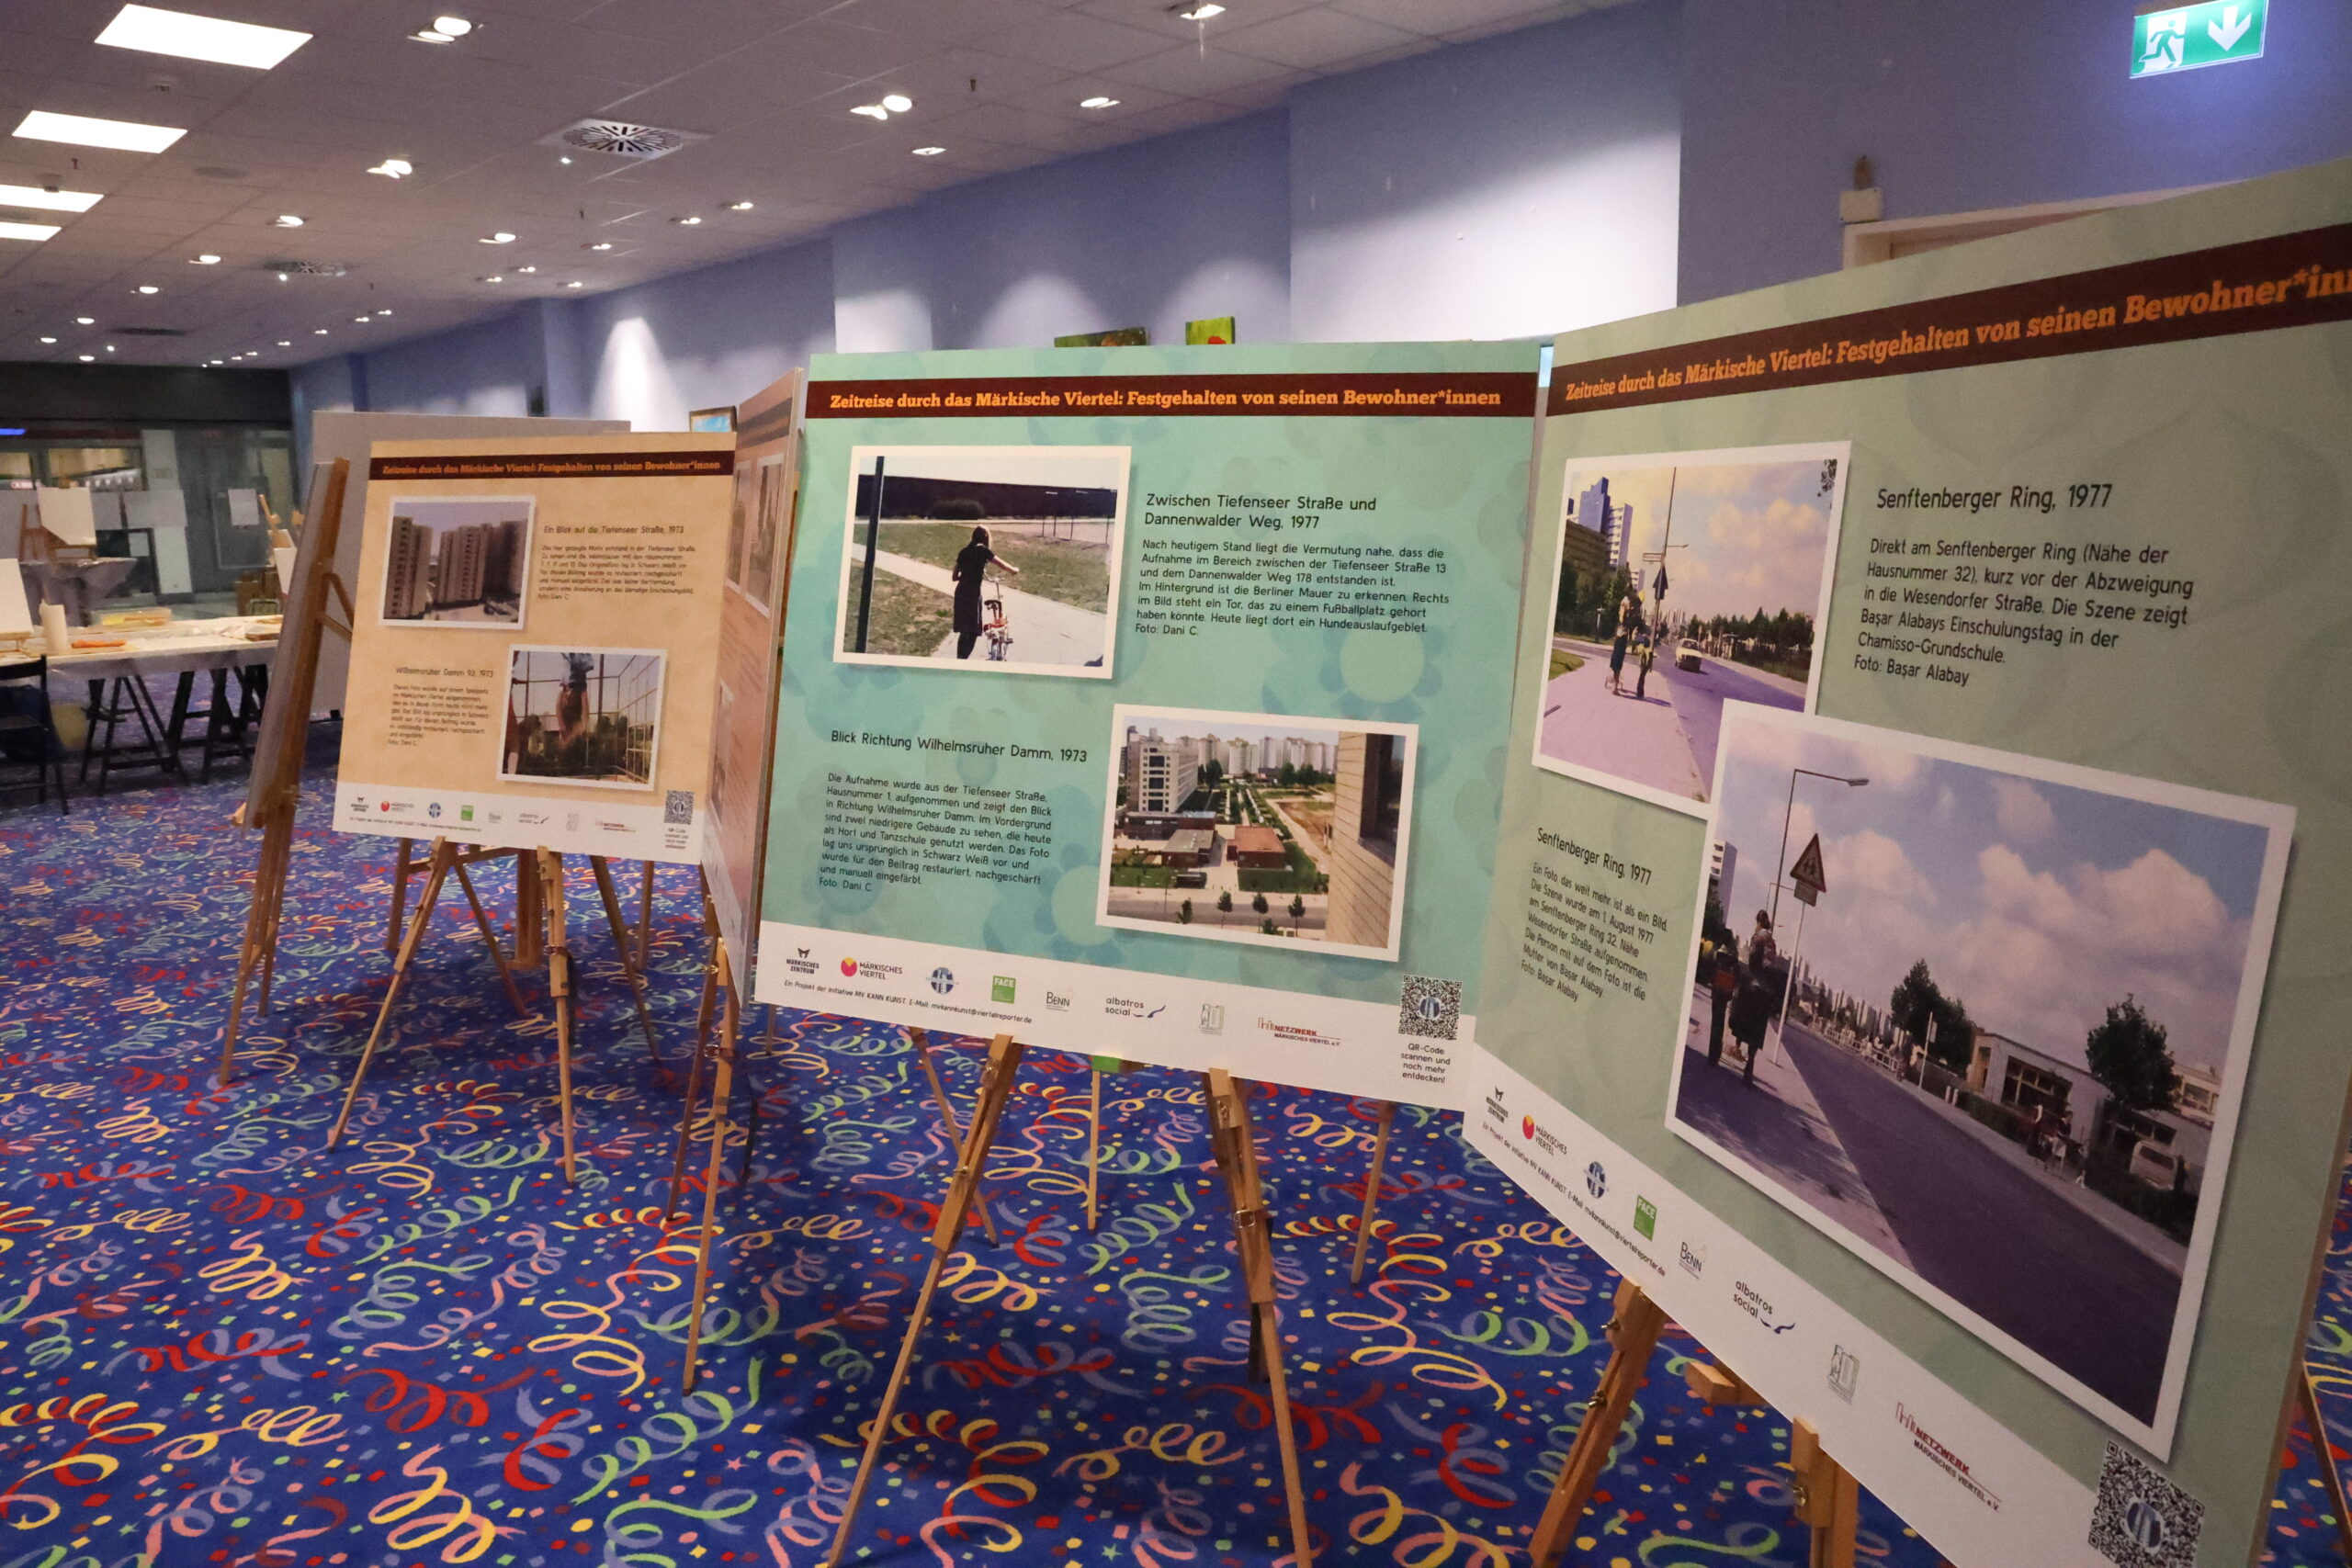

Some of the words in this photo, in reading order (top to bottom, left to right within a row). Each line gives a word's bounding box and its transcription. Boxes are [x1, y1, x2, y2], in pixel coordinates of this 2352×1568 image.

[1565, 378, 1616, 400] Zeitreise
[1617, 369, 1655, 393] durch
[1657, 367, 1682, 388] das
[1684, 355, 1766, 384] Märkische
[1770, 344, 1832, 372] Viertel:
[1835, 328, 1969, 364] Festgehalten
[1975, 321, 2020, 344] von
[2026, 309, 2116, 337] seinen
[830, 393, 894, 408] Zeitreise
[897, 392, 941, 407] durch
[944, 392, 972, 407] das
[975, 390, 1060, 406] Märkische
[1063, 390, 1124, 405] Viertel:
[1126, 389, 1237, 409] Festgehalten
[1241, 393, 1274, 404] von
[1278, 389, 1339, 404] seinen
[1146, 492, 1210, 507] Zwischen
[1216, 494, 1291, 508] Tiefenseer
[1350, 497, 1376, 510] und
[1876, 487, 2002, 513] Senftenberger
[2009, 485, 2055, 513] Ring,
[2068, 483, 2112, 507] 1977
[1144, 512, 1242, 526] Dannenwalder
[1249, 514, 1283, 531] Weg,
[1291, 515, 1319, 528] 1977
[1142, 538, 1167, 548] Nach
[1170, 539, 1218, 552] heutigem
[1223, 541, 1251, 552] Stand
[1255, 542, 1277, 555] liegt
[1282, 543, 1298, 553] die
[1303, 544, 1361, 558] Vermutung
[1398, 547, 1422, 558] dass
[1427, 547, 1444, 558] die
[1870, 537, 1906, 554] Direkt
[1910, 543, 1930, 555] am
[1936, 539, 2036, 563] Senftenberger
[2042, 542, 2076, 565] Ring
[2138, 545, 2169, 564] der
[1141, 553, 1193, 564] Aufnahme
[1196, 555, 1209, 564] im
[1213, 555, 1251, 566] Bereich
[1255, 558, 1305, 568] zwischen
[1308, 558, 1327, 569] der
[1331, 558, 1389, 570] Tiefenseer
[1435, 562, 1446, 573] 13
[1139, 568, 1159, 577] und
[1162, 568, 1184, 578] dem
[1188, 569, 1262, 581] Dannenwalder
[1266, 571, 1292, 584] Weg
[1296, 572, 1312, 582] 178
[1316, 574, 1376, 585] entstanden
[1867, 561, 1948, 581] Hausnummer
[1984, 566, 2014, 585] kurz
[2020, 572, 2045, 586] vor
[2051, 570, 2078, 588] der
[2085, 571, 2194, 598] Abzweigung
[1138, 581, 1151, 591] Im
[1155, 581, 1214, 594] Hintergrund
[1217, 584, 1229, 594] ist
[1233, 584, 1250, 595] die
[1253, 585, 1294, 597] Berliner
[1298, 587, 1333, 598] Mauer
[1337, 591, 1350, 599] zu
[1412, 592, 1449, 604] Rechts
[1137, 595, 1150, 604] im
[1154, 595, 1171, 605] Bild
[1175, 597, 1201, 607] steht
[1205, 598, 1221, 608] ein
[1247, 600, 1265, 610] das
[1269, 603, 1282, 611] zu
[1285, 602, 1318, 612] einem
[1323, 603, 1385, 616] Fußballplatz
[1863, 584, 1874, 600] in
[1879, 586, 1896, 602] die
[1903, 587, 1988, 609] Wesendorfer
[2052, 596, 2077, 616] Die
[2085, 599, 2135, 620] Szene
[2143, 605, 2188, 627] zeigt
[1136, 609, 1166, 619] haben
[1210, 612, 1241, 624] Heute
[1245, 614, 1268, 626] liegt
[1272, 615, 1295, 626] dort
[1298, 616, 1315, 626] ein
[1135, 623, 1159, 634] Foto:
[1162, 624, 1184, 635] Dani
[1897, 611, 1945, 633] Alabays
[1950, 615, 2063, 647] Einschulungstag
[2069, 626, 2084, 644] in
[2090, 628, 2119, 648] der
[1858, 631, 2005, 663] Chamisso-Grundschule.
[1854, 653, 1882, 671] Foto:
[1925, 663, 1970, 687] Alabay
[831, 729, 856, 743] Blick
[861, 732, 911, 750] Richtung
[917, 737, 1005, 755] Wilhelmsruher
[1010, 744, 1053, 761] Damm,
[1537, 827, 1600, 864] Senftenberger
[1602, 852, 1625, 877] Ring,
[1631, 863, 1652, 885] 1977
[859, 961, 902, 974] MÄRKISCHES
[859, 969, 886, 980] VIERTEL
[993, 976, 1015, 988] FACE
[1104, 1007, 1130, 1016] social
[1105, 997, 1144, 1009] albatros
[1408, 1043, 1444, 1055] QR-Code
[1400, 1053, 1432, 1062] scannen
[1435, 1057, 1451, 1066] und
[1402, 1063, 1421, 1071] noch
[1424, 1066, 1446, 1074] mehr
[1402, 1072, 1445, 1083] entdecken!
[1535, 1125, 1566, 1155] MÄRKISCHES
[1535, 1135, 1554, 1156] VIERTEL
